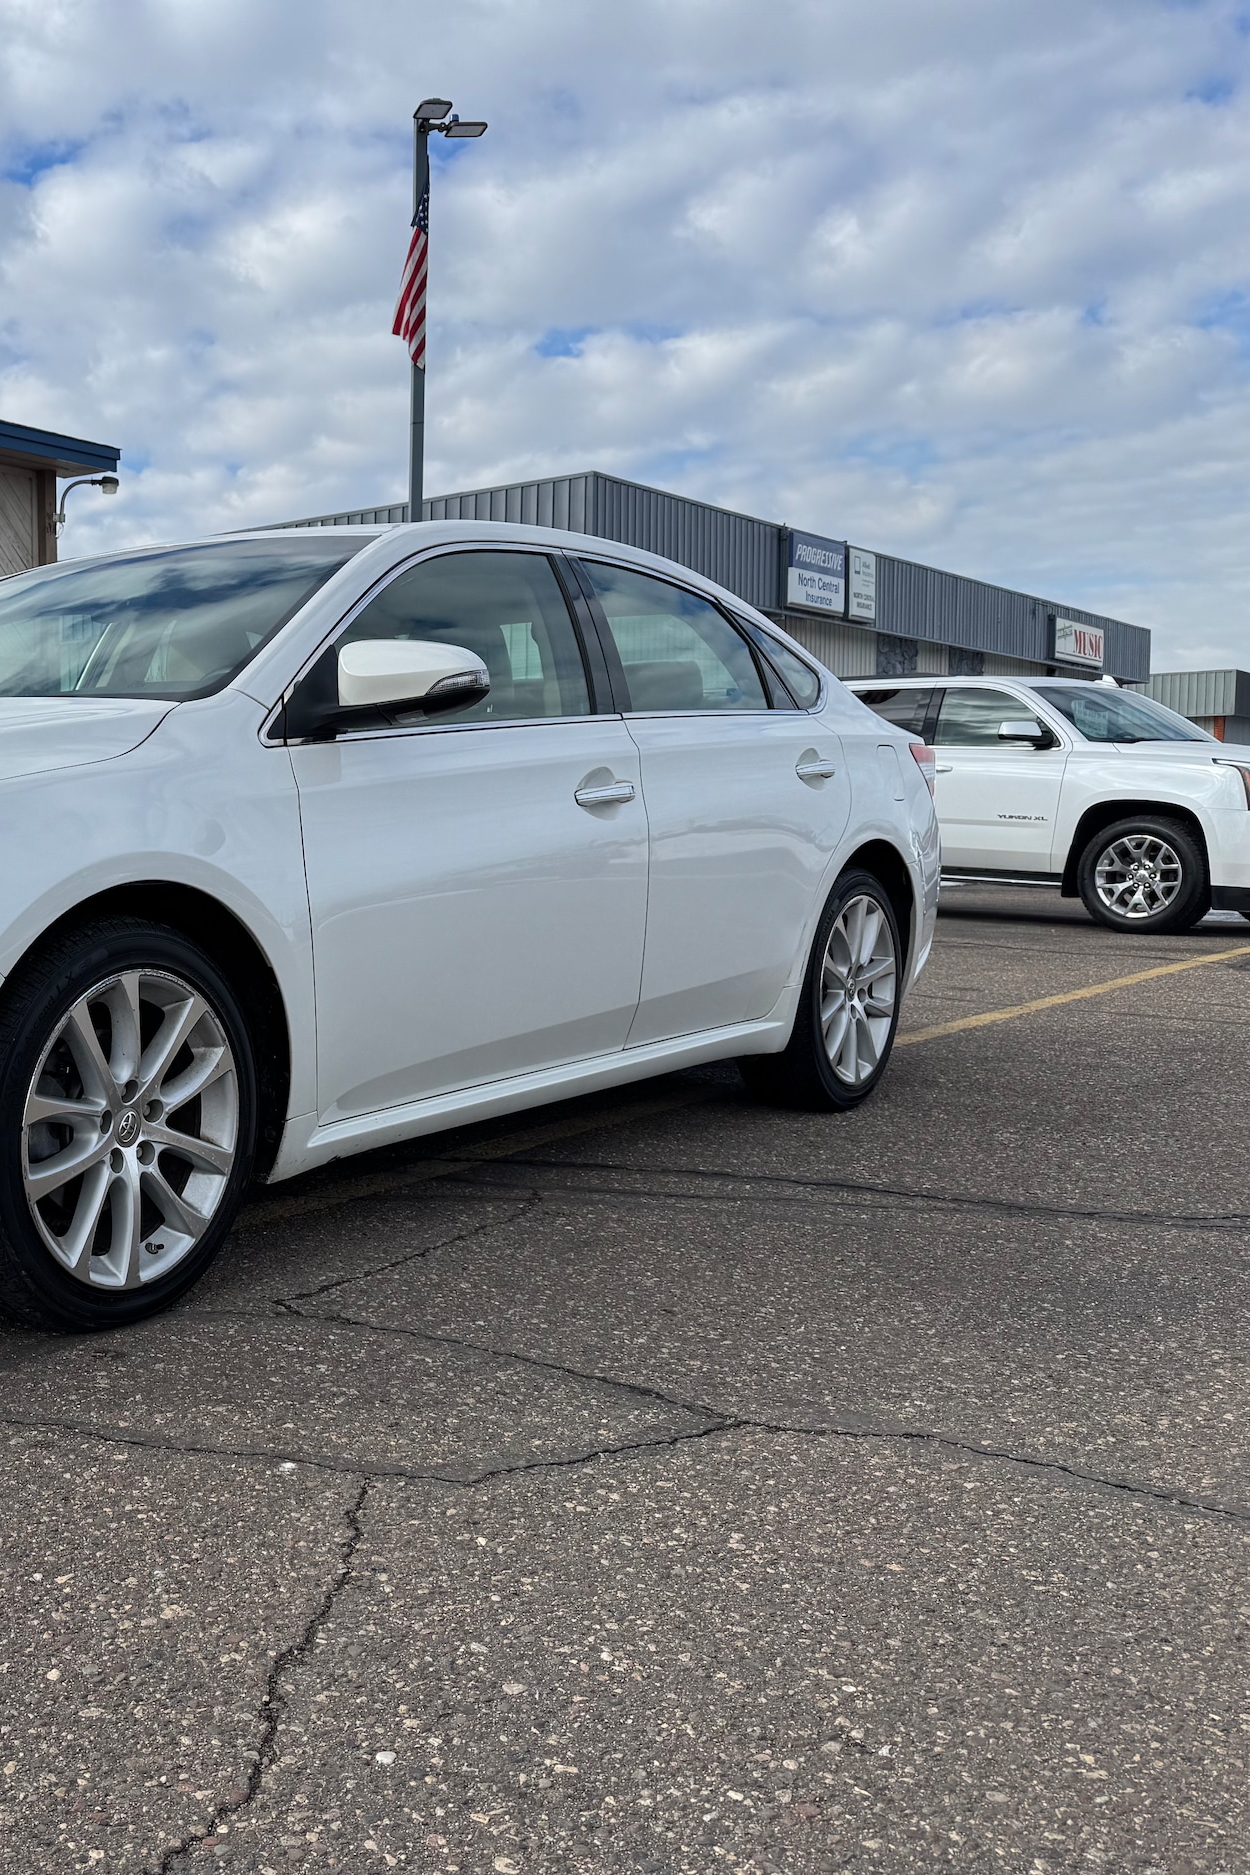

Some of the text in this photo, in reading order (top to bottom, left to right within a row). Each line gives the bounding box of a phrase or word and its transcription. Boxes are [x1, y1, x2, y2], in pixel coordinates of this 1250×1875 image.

[795, 544, 843, 570] PROGRESSIVE
[798, 573, 840, 594] North Central
[805, 591, 832, 607] Insurance
[1073, 629, 1103, 659] MUSIC
